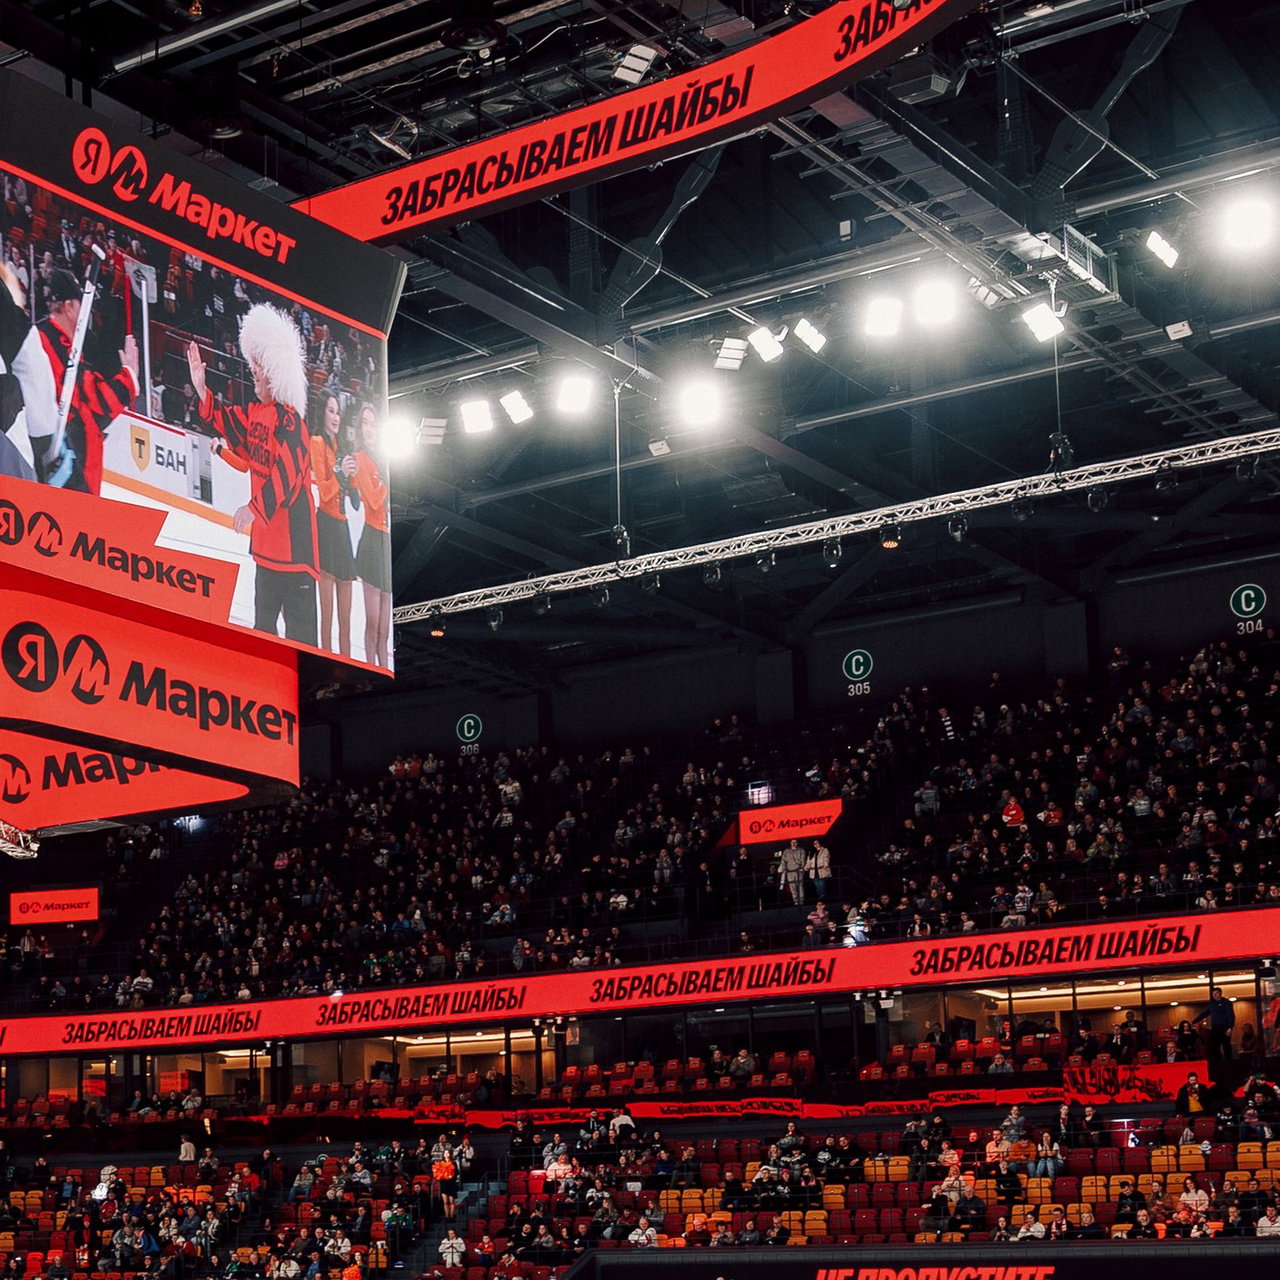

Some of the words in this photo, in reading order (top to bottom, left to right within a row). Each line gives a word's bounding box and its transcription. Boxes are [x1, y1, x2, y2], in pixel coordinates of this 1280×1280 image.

[381, 114, 618, 226] ЗАБРАСЫВАЕМ
[619, 65, 755, 144] ШАЙБЫ
[149, 172, 297, 266] Маркет
[70, 532, 216, 598] Маркет
[1237, 619, 1264, 635] 304
[118, 661, 297, 746] Маркет
[847, 682, 871, 696] 305
[460, 743, 480, 757] 306
[777, 813, 834, 831] Маркет
[42, 899, 91, 912] Маркет
[910, 933, 1096, 977] ЗАБРАСЫВАЕМ
[1097, 923, 1201, 960] ШАЙБЫ
[590, 965, 746, 1003] ЗАБРАСЫВАЕМ
[747, 956, 836, 990] ШАЙБЫ
[317, 991, 455, 1025] ЗАБРАСЫВАЕМ
[453, 984, 527, 1013] ШАЙБЫ
[62, 1017, 195, 1043] ЗАБРАСЫВАЕМ
[194, 1008, 262, 1035] ШАЙБЫ
